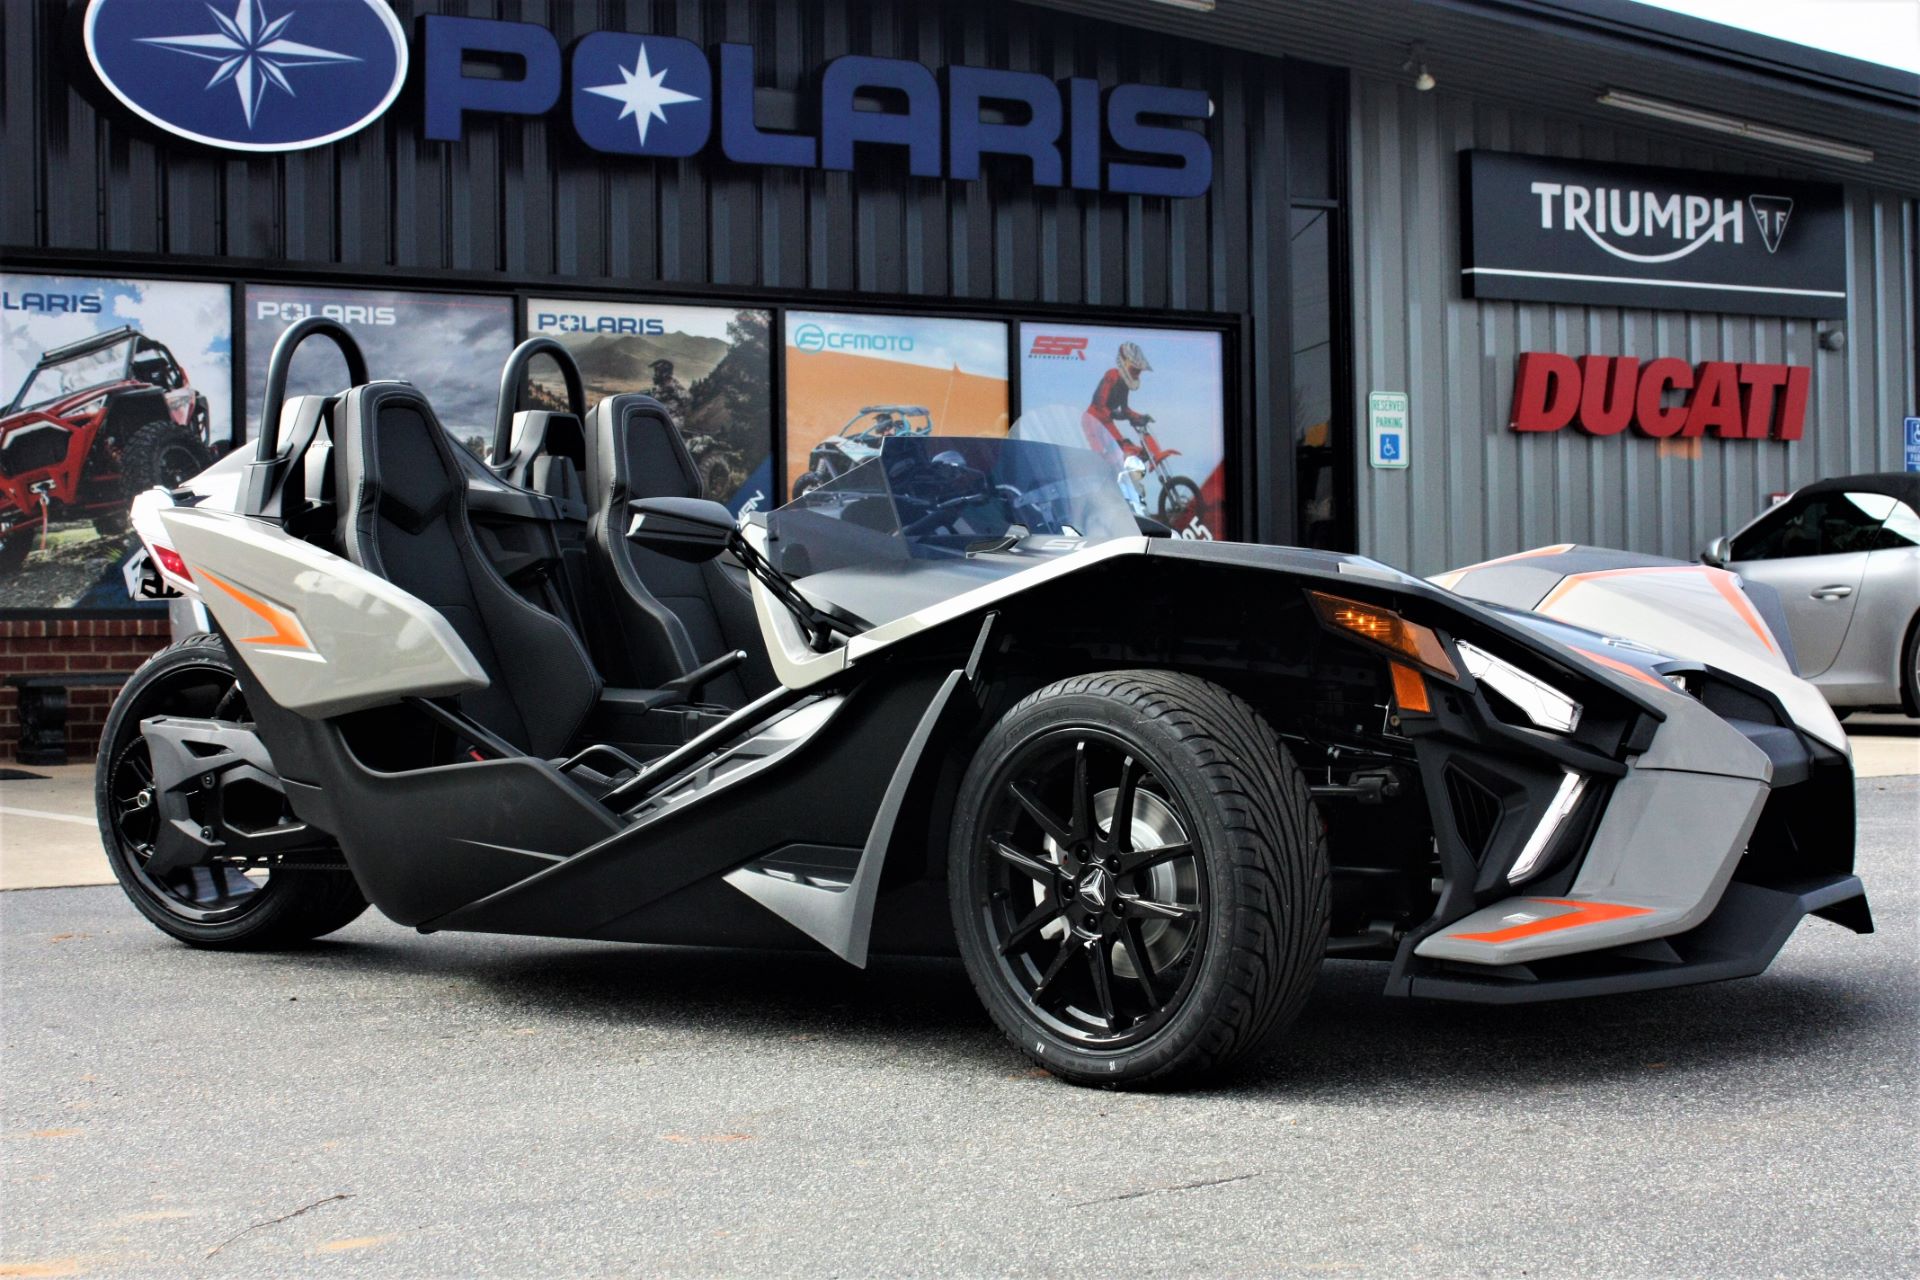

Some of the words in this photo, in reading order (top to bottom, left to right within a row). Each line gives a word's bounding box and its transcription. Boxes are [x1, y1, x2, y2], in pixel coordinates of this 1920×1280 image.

[424, 13, 1212, 197] POLARIS
[1530, 181, 1744, 263] TRIUMPH
[256, 301, 397, 326] POLARIS
[538, 313, 664, 336] POLARIS
[827, 332, 915, 352] CFMOTO
[1030, 335, 1089, 361] SSR
[1371, 399, 1405, 412] RESERVED
[1509, 351, 1811, 442] DUCATI
[1375, 415, 1403, 428] PARKING
